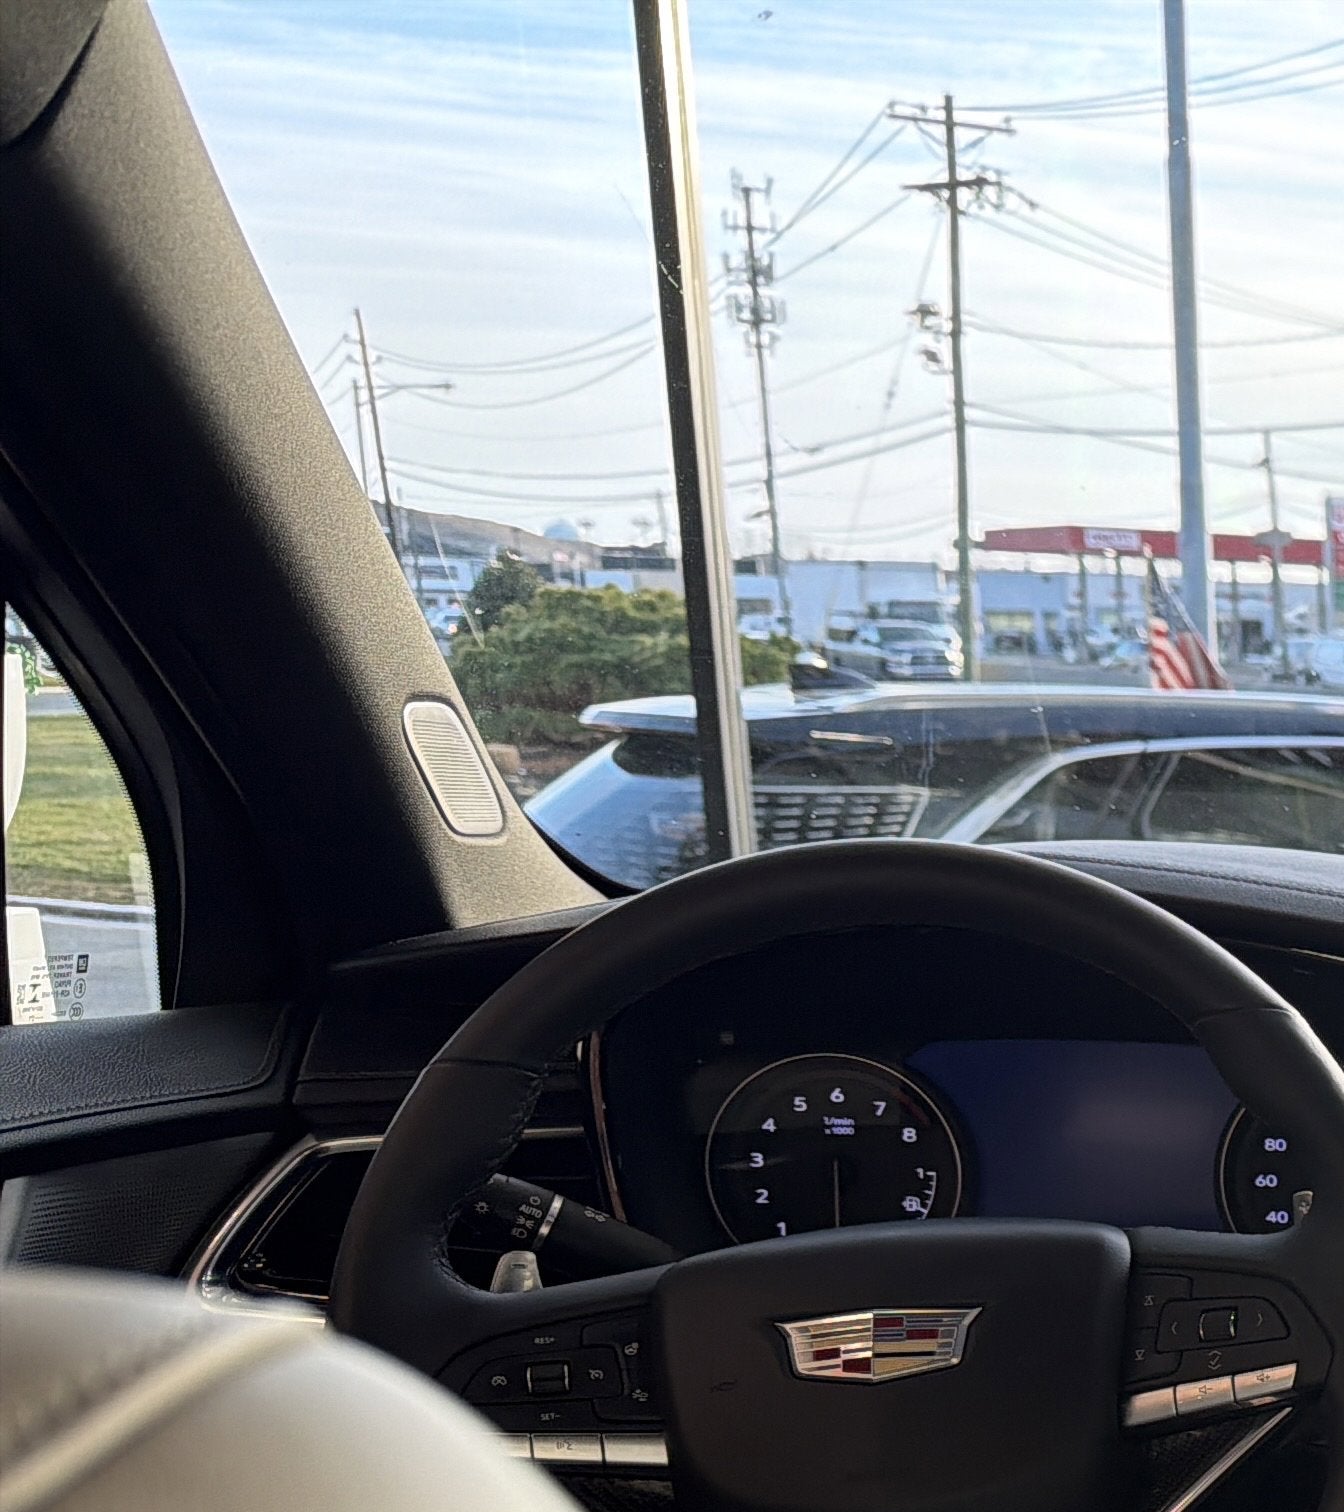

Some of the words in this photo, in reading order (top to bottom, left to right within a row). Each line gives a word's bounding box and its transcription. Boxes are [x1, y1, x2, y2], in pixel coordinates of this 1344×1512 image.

[830, 1088, 845, 1103] 6
[793, 1096, 808, 1112] 5
[873, 1101, 886, 1116] 7
[762, 1118, 776, 1133] 4
[903, 1128, 917, 1142] 8
[1264, 1138, 1287, 1152] 80
[750, 1152, 764, 1167] 3
[1254, 1174, 1278, 1188] 60
[755, 1189, 769, 1203] 2
[519, 1204, 542, 1219] AUTO
[1265, 1211, 1289, 1224] 40
[777, 1222, 786, 1236] 1
